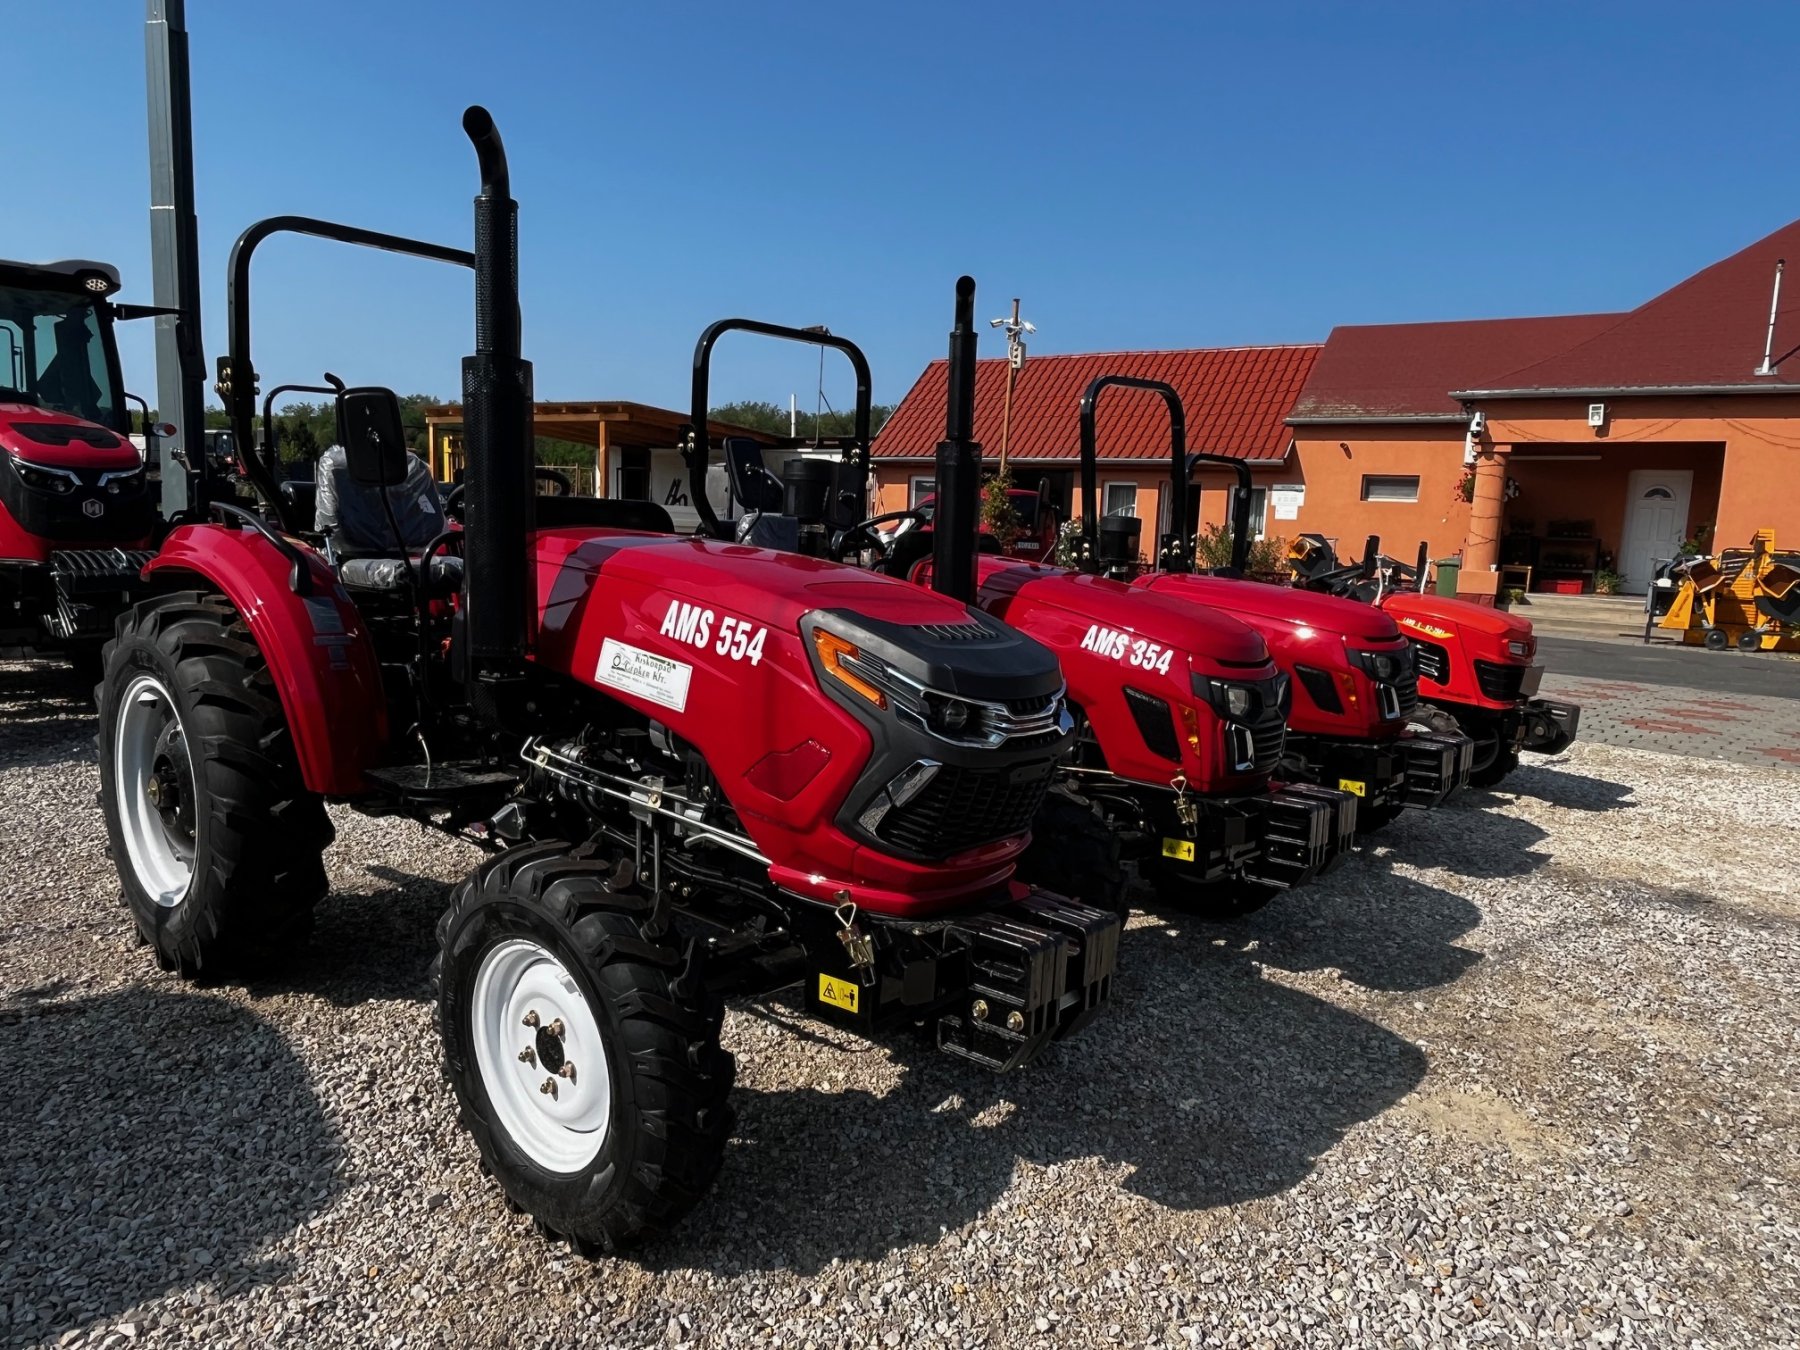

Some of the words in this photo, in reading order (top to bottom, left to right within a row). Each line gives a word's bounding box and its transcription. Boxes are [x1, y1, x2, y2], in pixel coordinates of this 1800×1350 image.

[660, 600, 714, 648] AMS
[716, 616, 767, 666] 554
[1080, 625, 1130, 660] AMS
[1130, 640, 1174, 676] 354
